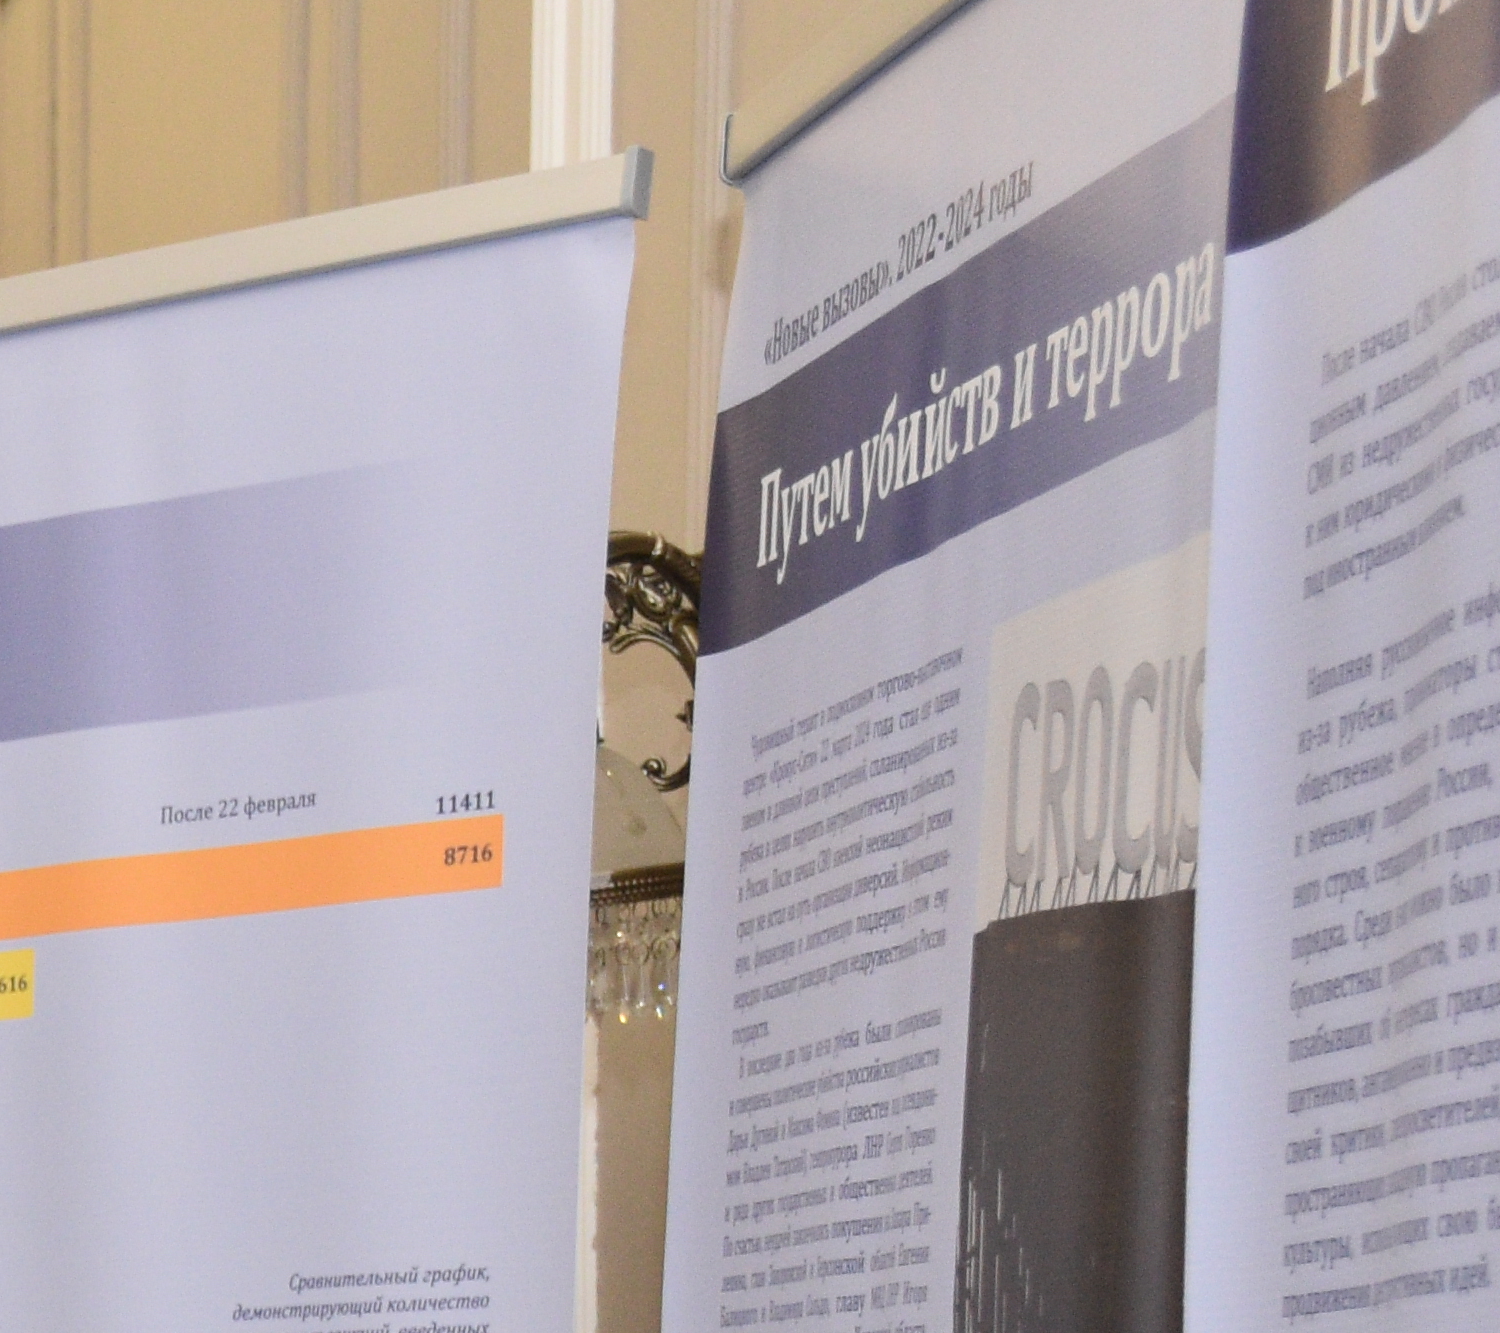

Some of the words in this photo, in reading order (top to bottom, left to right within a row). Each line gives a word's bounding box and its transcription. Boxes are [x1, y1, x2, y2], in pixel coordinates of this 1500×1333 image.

[763, 315, 820, 366] «Новые
[822, 258, 894, 332] вызовы».
[896, 179, 984, 283] 2022-2024
[988, 161, 1034, 224] годы
[756, 448, 855, 586] Путем
[855, 367, 1002, 543] убийств
[1009, 343, 1038, 430] и
[1044, 241, 1216, 422] террора
[160, 804, 214, 827] После
[217, 796, 239, 820] 22
[243, 791, 317, 822] февраля
[435, 791, 496, 815] 11411
[444, 843, 494, 867] 8716
[288, 1265, 419, 1293] Сравнительный
[422, 1263, 490, 1288] график,
[231, 1295, 383, 1323] демонстрирующий
[386, 1294, 491, 1314] количество
